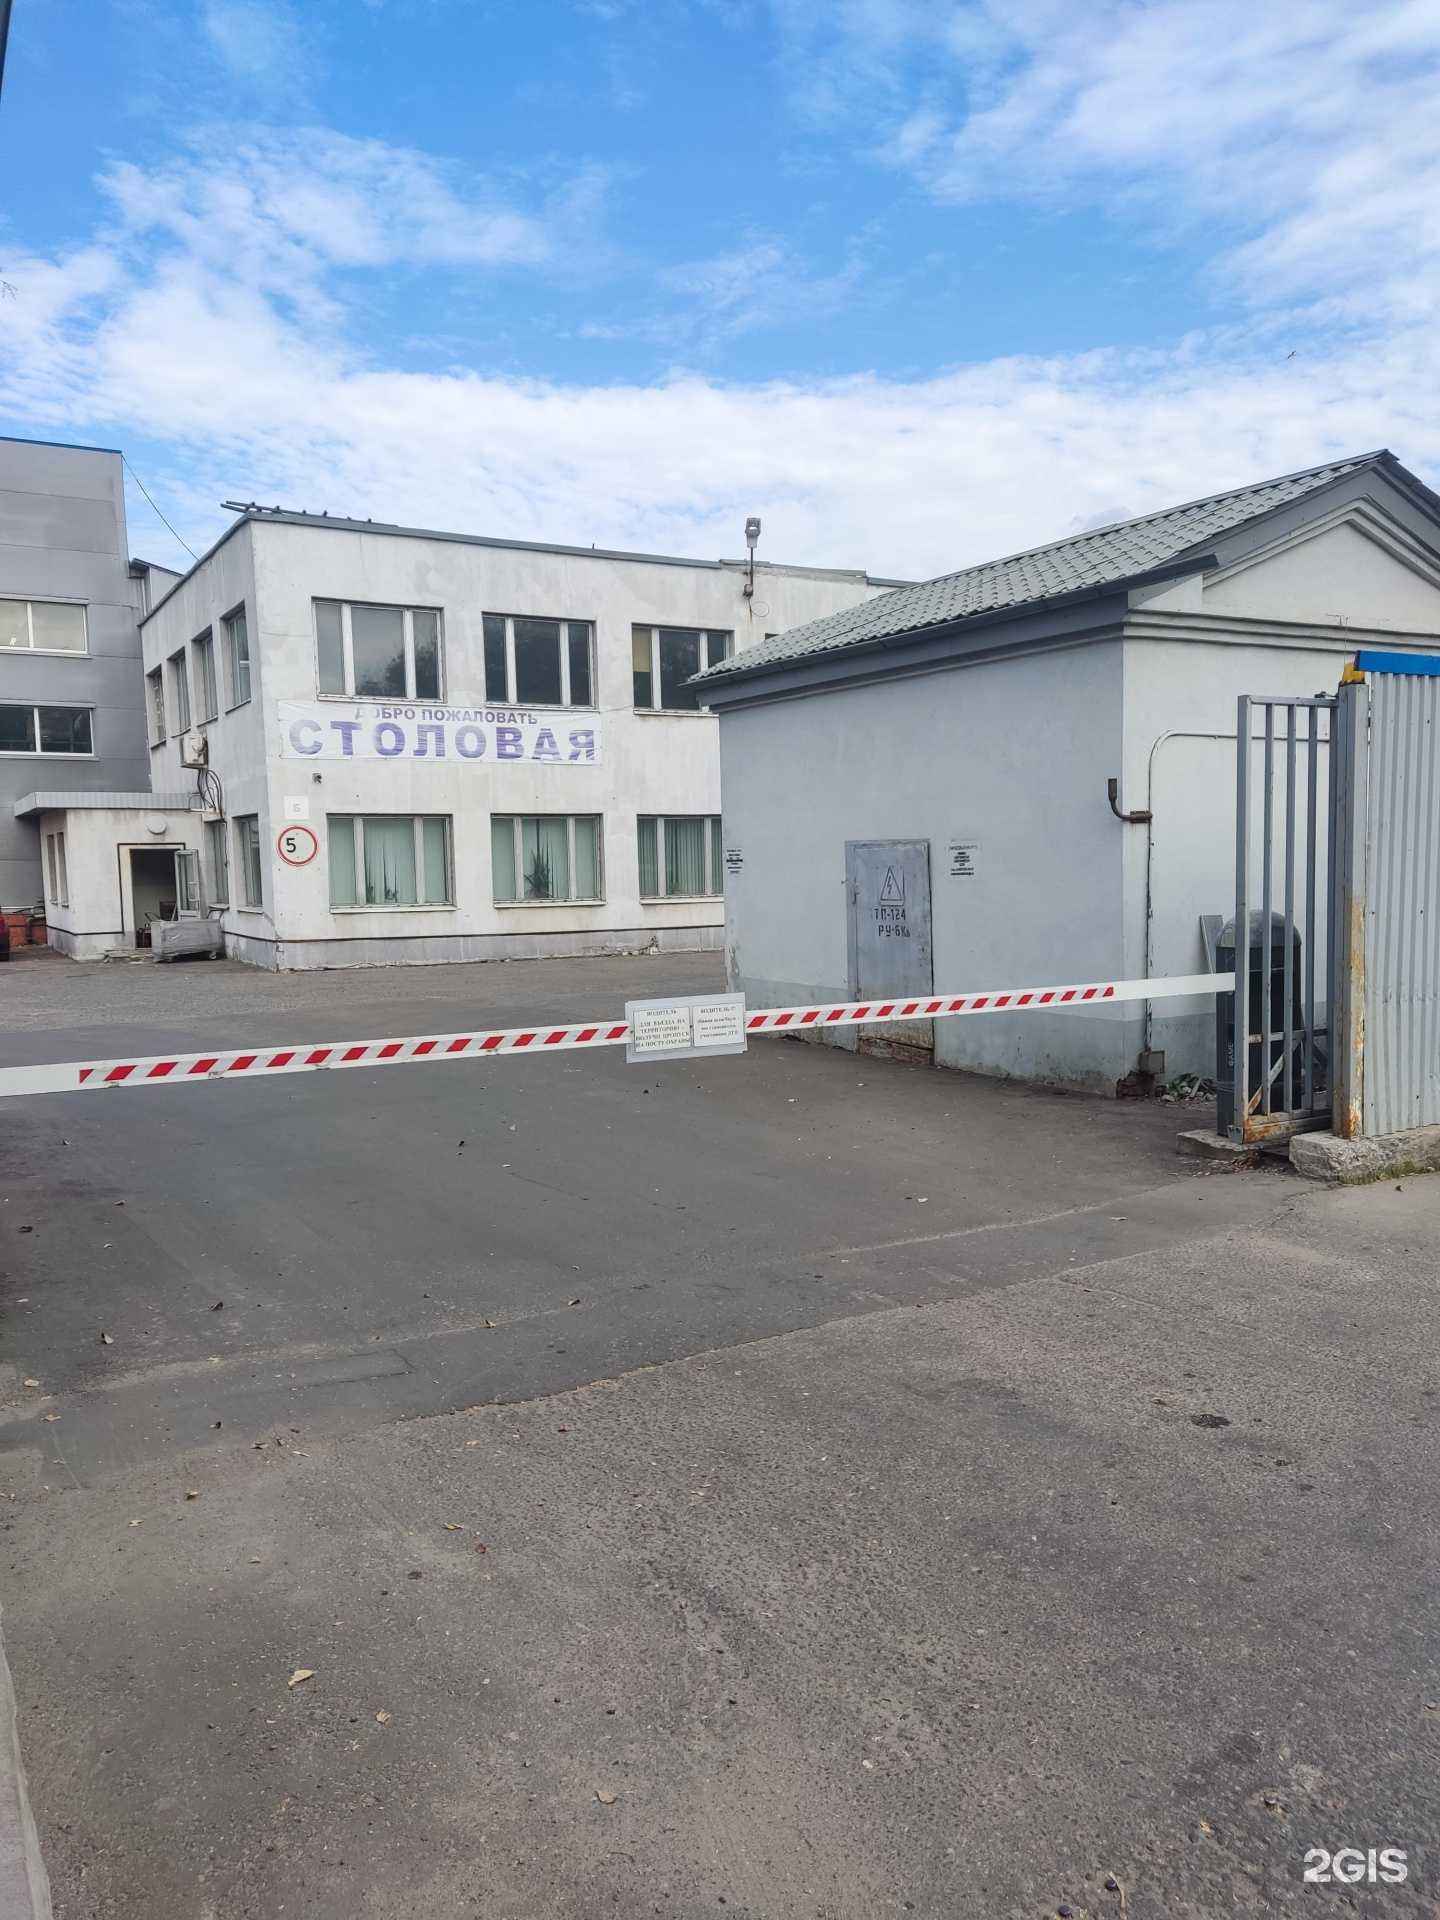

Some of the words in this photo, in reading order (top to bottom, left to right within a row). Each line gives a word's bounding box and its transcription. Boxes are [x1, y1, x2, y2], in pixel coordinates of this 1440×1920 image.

[421, 708, 538, 725] ПОЖАЛОВАТЬ
[288, 719, 596, 761] СТОЛОВАЯ
[286, 837, 297, 853] 5
